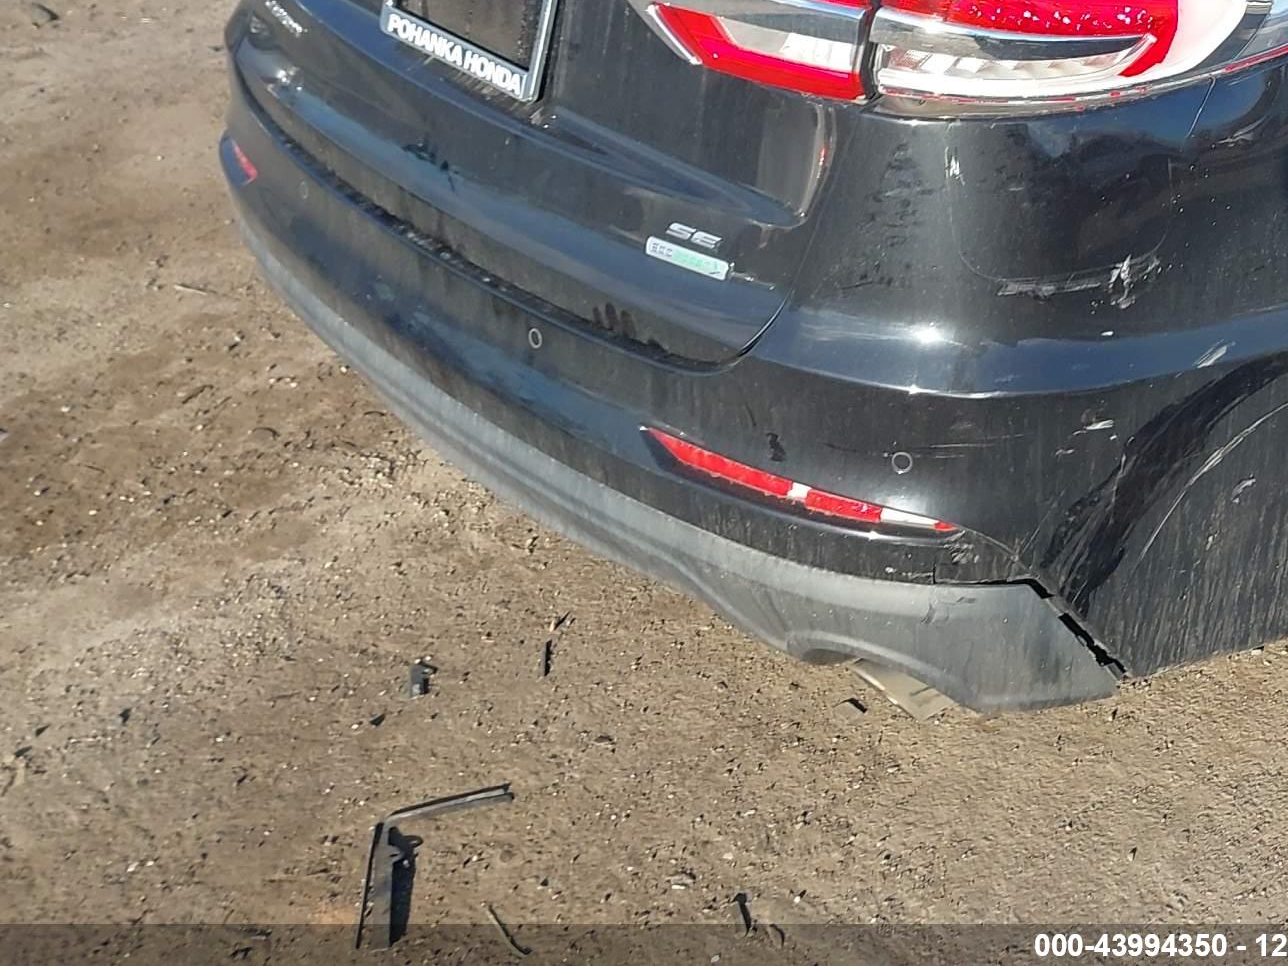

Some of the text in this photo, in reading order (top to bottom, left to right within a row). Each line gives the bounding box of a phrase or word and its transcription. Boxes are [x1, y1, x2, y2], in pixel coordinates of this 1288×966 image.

[386, 13, 523, 97] POHANKA HONDA
[665, 222, 722, 249] SE
